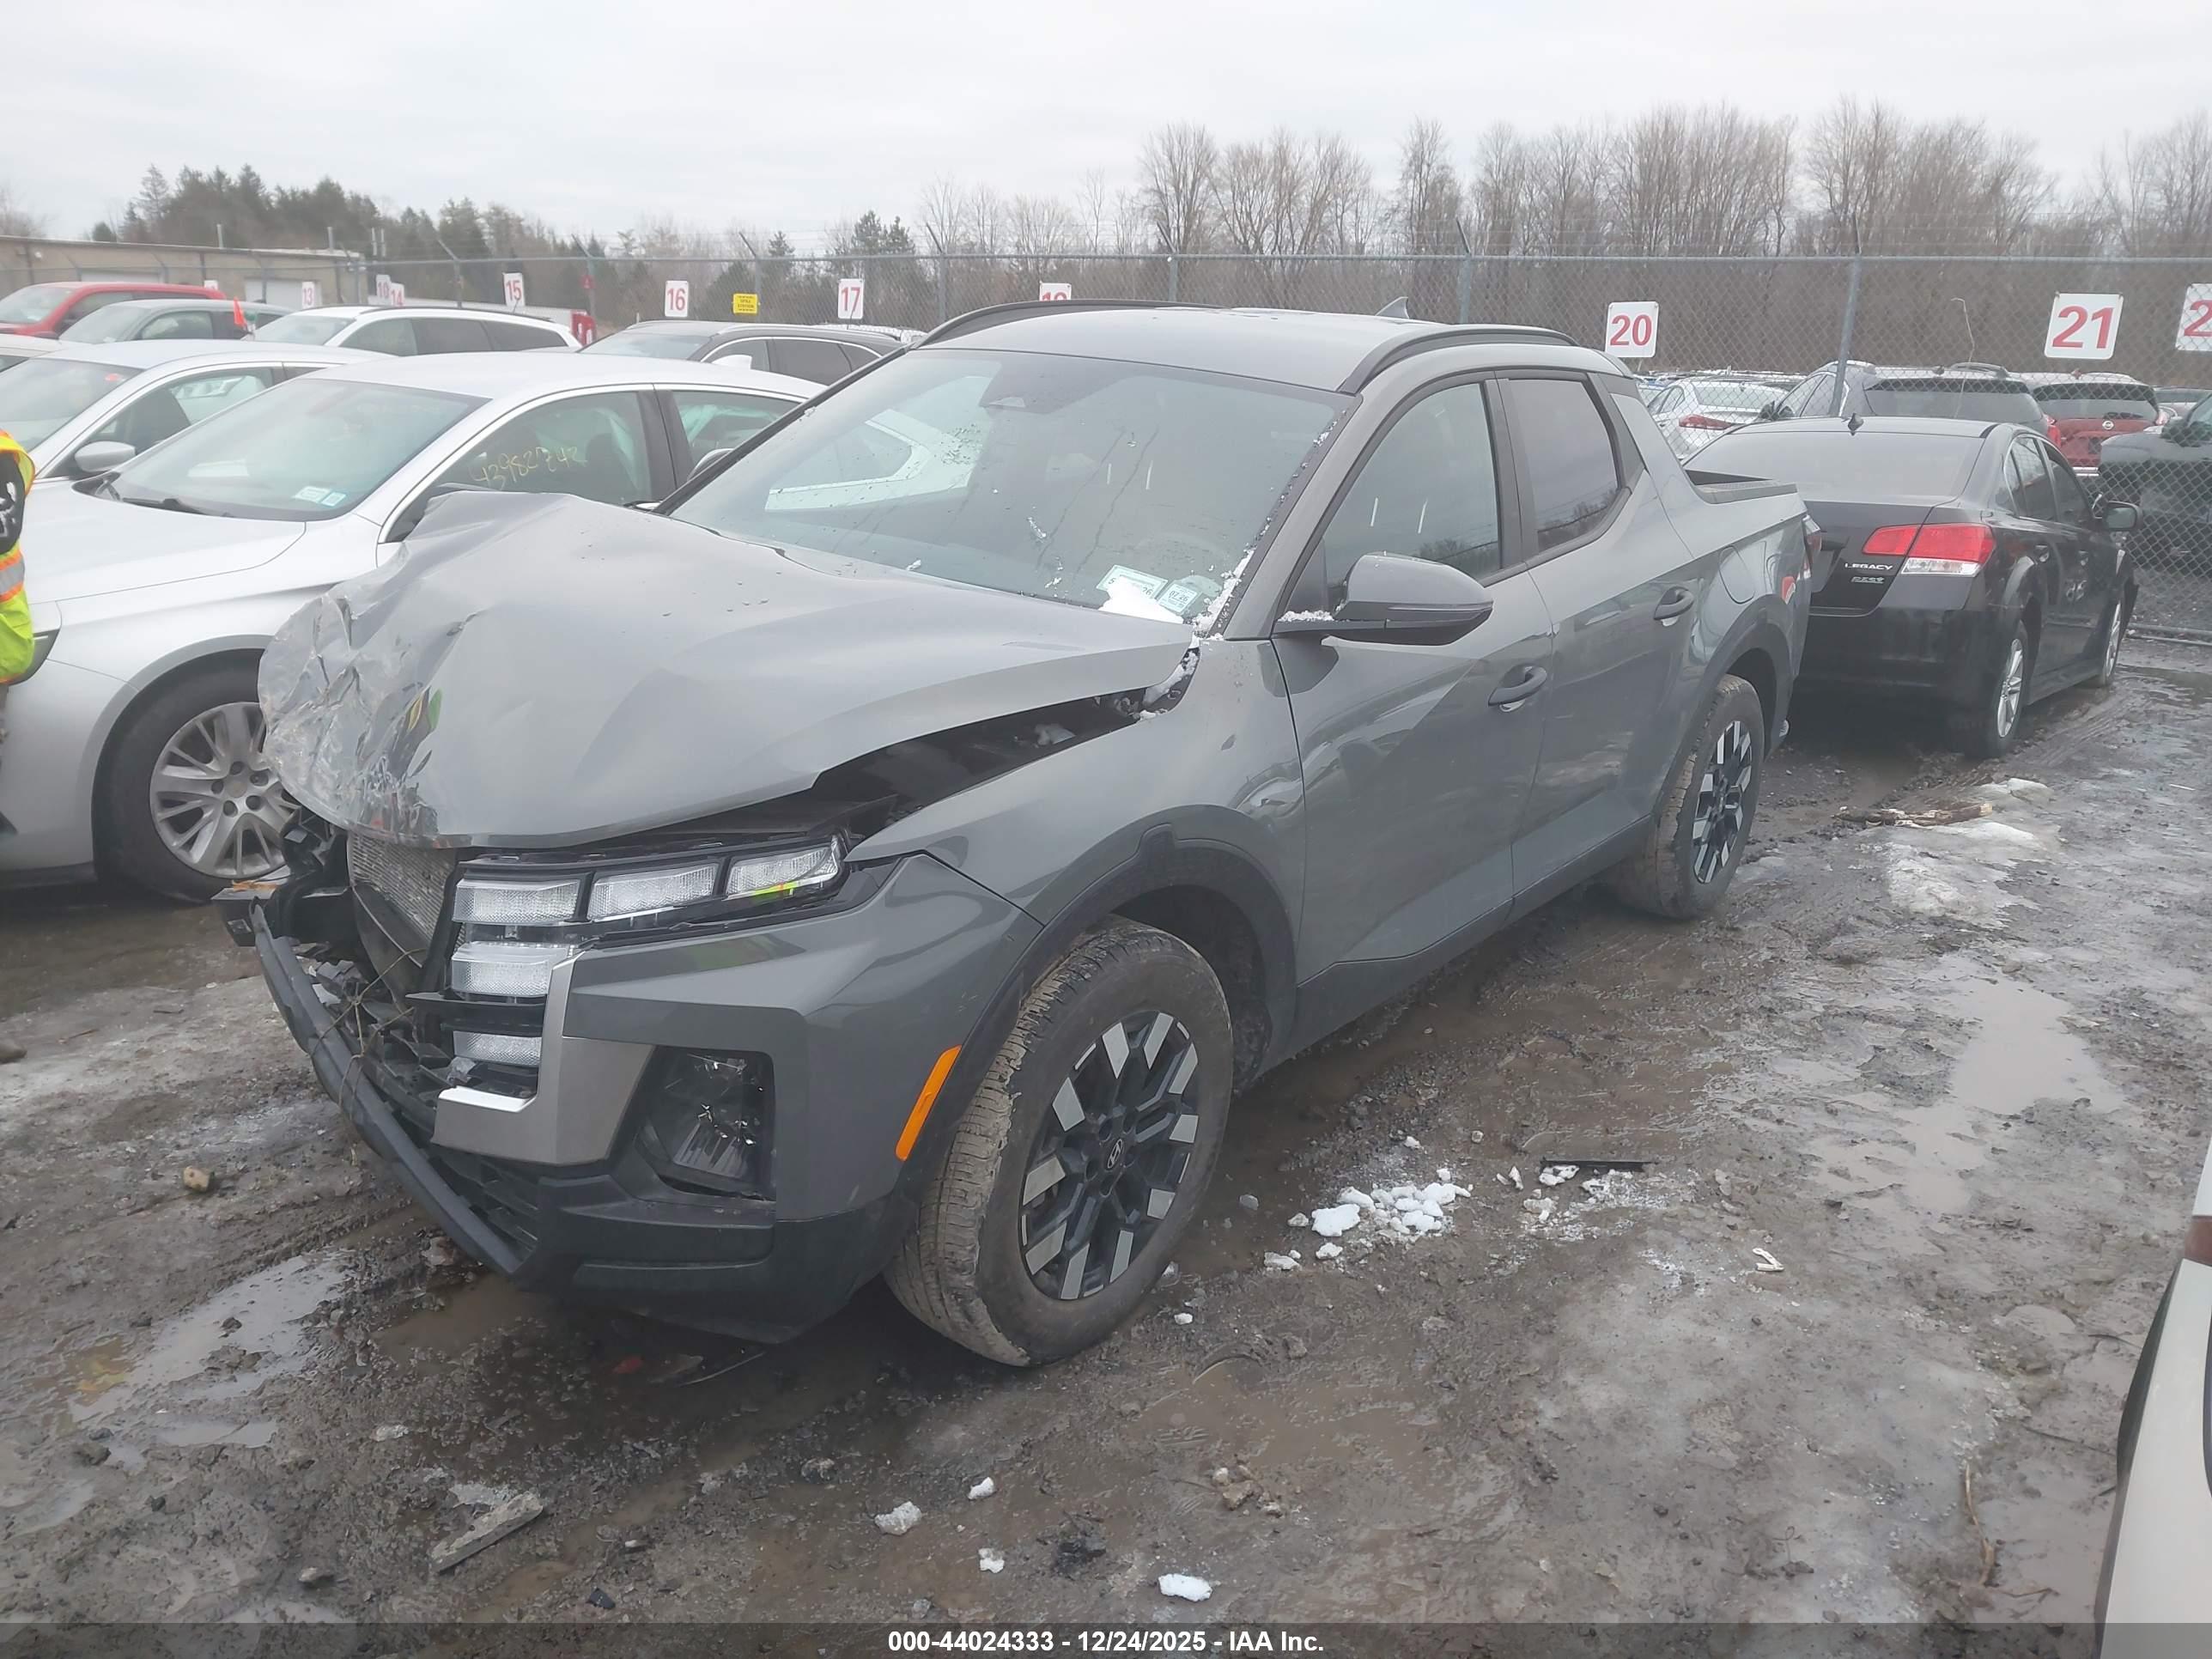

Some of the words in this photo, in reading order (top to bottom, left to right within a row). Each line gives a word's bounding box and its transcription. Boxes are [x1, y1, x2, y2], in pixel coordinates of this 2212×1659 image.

[303, 288, 313, 306] 13
[506, 280, 522, 301] 15
[667, 288, 685, 311] 16
[841, 287, 860, 312] 17
[1610, 315, 1652, 345] 20
[2051, 306, 2113, 349] 21
